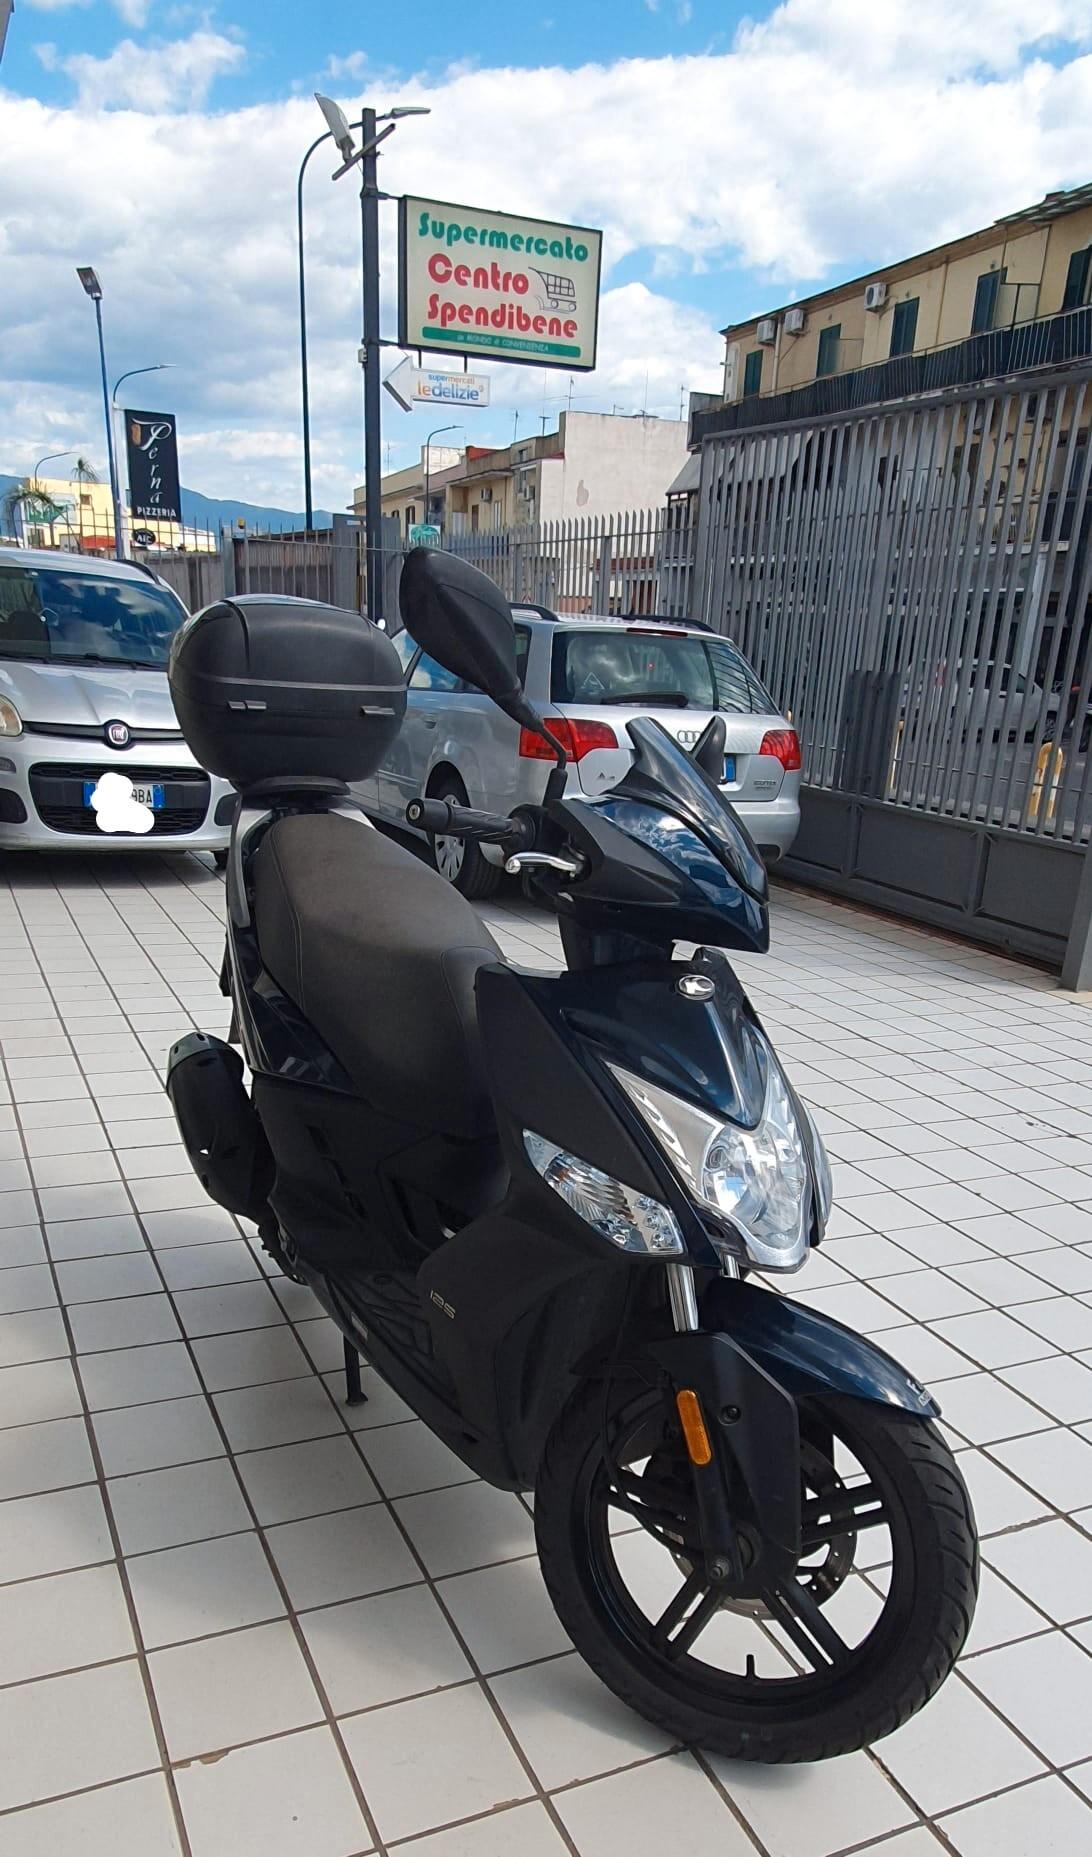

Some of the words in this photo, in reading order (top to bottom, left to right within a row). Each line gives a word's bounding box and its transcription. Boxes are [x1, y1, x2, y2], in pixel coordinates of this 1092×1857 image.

[418, 212, 589, 262] Supermercato
[428, 253, 529, 295] Centro
[427, 294, 578, 338] Spendibene
[428, 374, 475, 384] supermercati
[137, 506, 177, 518] PIZZERIA
[430, 1289, 456, 1319] 125
